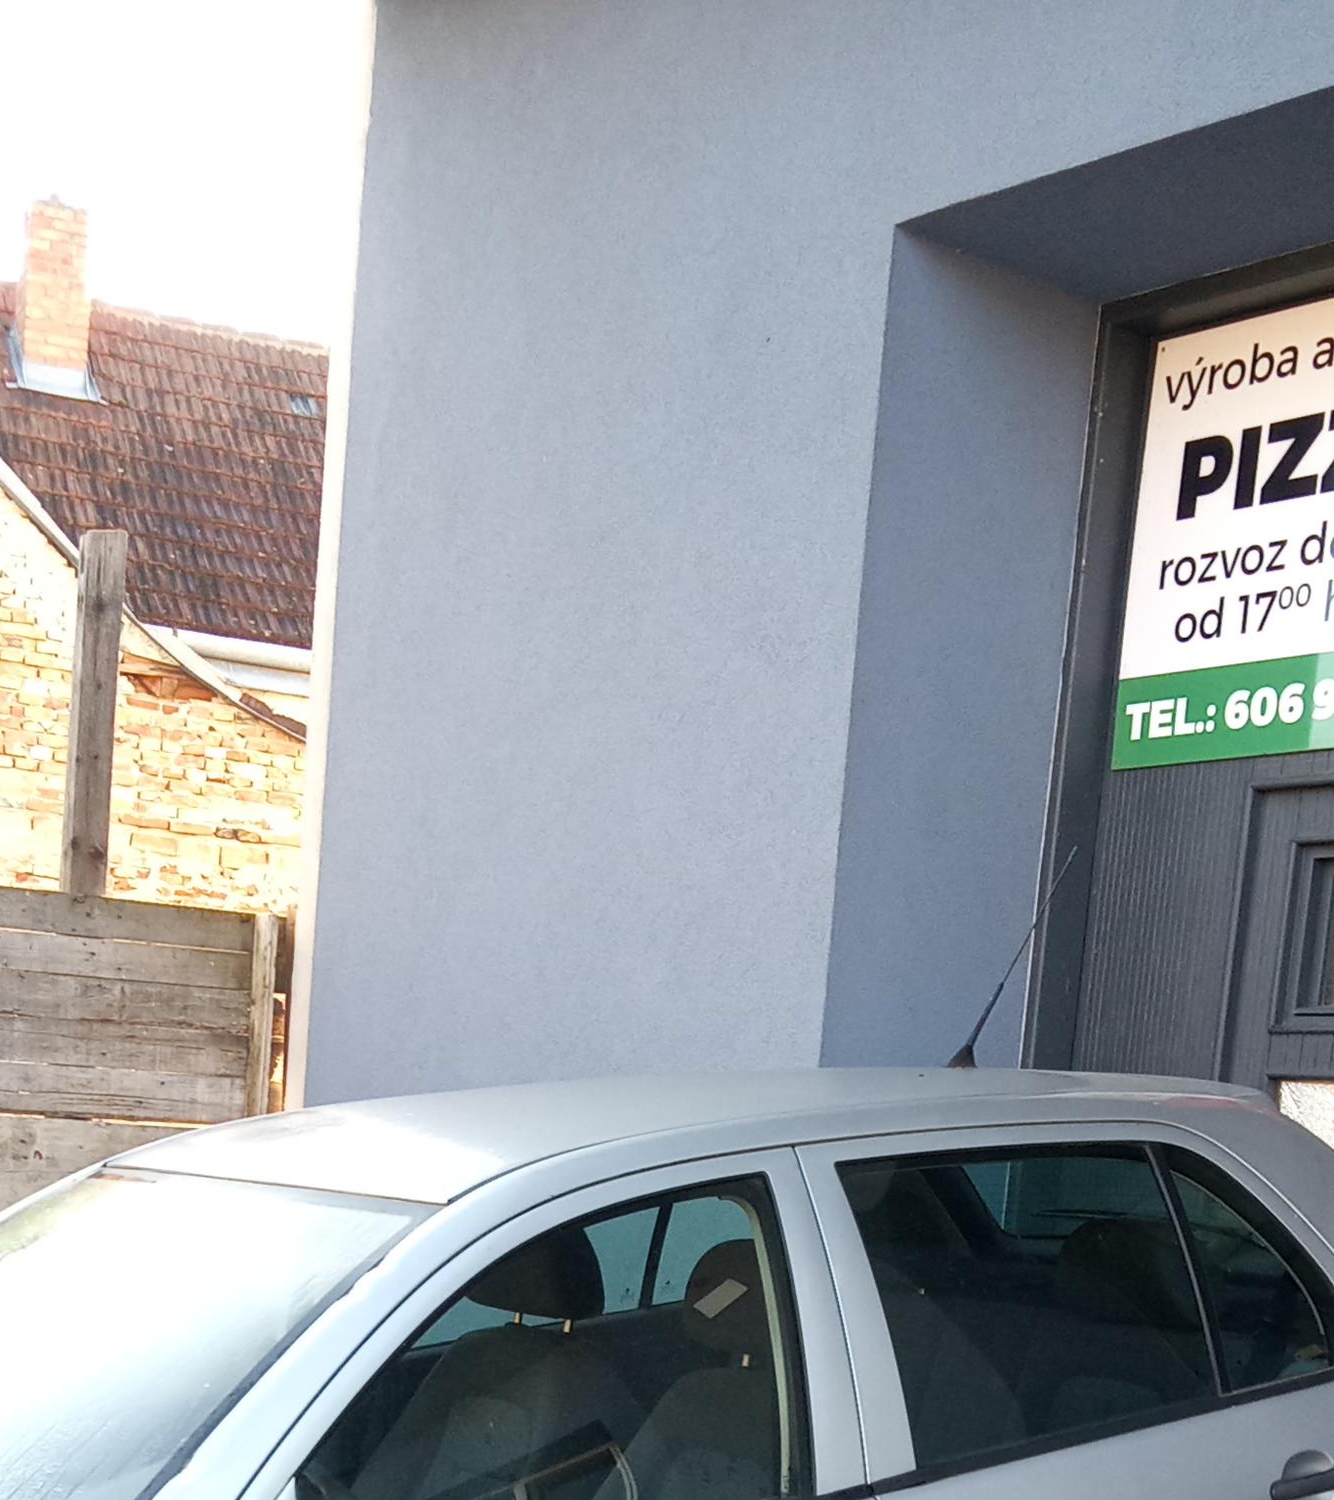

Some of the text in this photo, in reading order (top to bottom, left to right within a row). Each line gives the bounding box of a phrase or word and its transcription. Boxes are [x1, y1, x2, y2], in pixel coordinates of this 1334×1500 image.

[1165, 342, 1300, 412] výroba
[1158, 538, 1288, 590] rozvoz
[1174, 596, 1225, 643] od
[1125, 696, 1217, 741] TEL.:
[1224, 682, 1306, 730] 606
